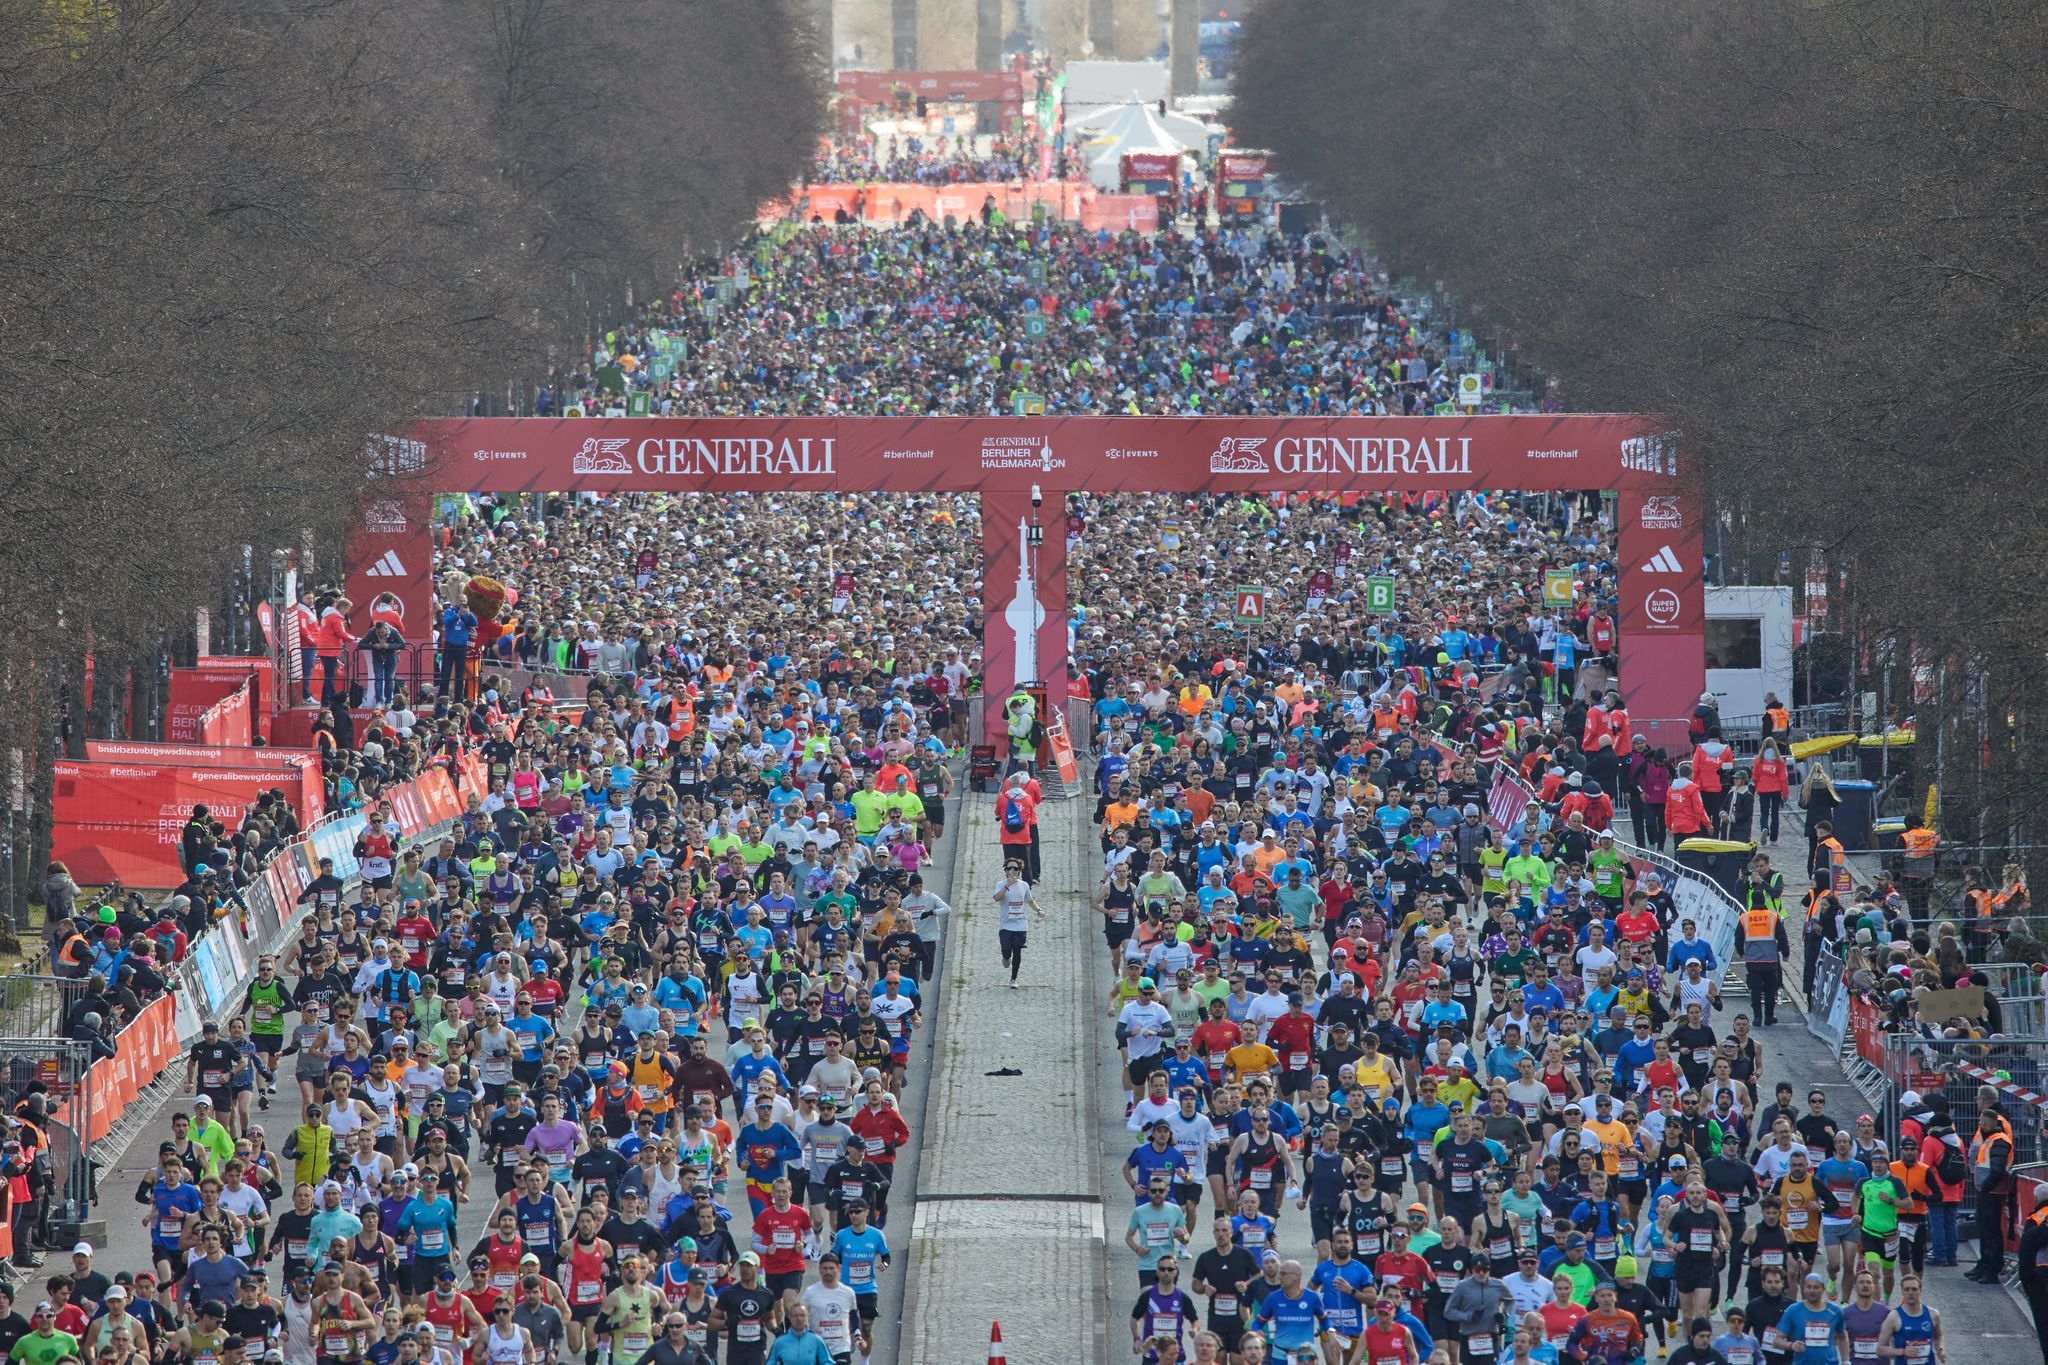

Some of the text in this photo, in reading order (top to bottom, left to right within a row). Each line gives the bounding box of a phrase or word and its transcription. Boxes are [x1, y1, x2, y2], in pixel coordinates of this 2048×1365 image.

[1031, 321, 1042, 334] D
[655, 364, 666, 377] D
[995, 437, 1041, 446] GENERALI
[473, 450, 489, 461] SCC
[636, 437, 836, 475] GENERALI
[883, 450, 934, 460] #berlinhalf
[981, 448, 1031, 458] BERLINER
[1105, 448, 1158, 459] SCC EVENTS
[1273, 437, 1473, 474] GENERALI
[1527, 449, 1578, 459] #berlinhalf
[637, 565, 652, 575] 1:35
[834, 589, 850, 599] 1:35
[1309, 588, 1326, 598] 1:35
[1551, 579, 1567, 599] C
[1373, 585, 1388, 606] B
[1241, 595, 1259, 616] A
[110, 767, 158, 778] #berlinhalf
